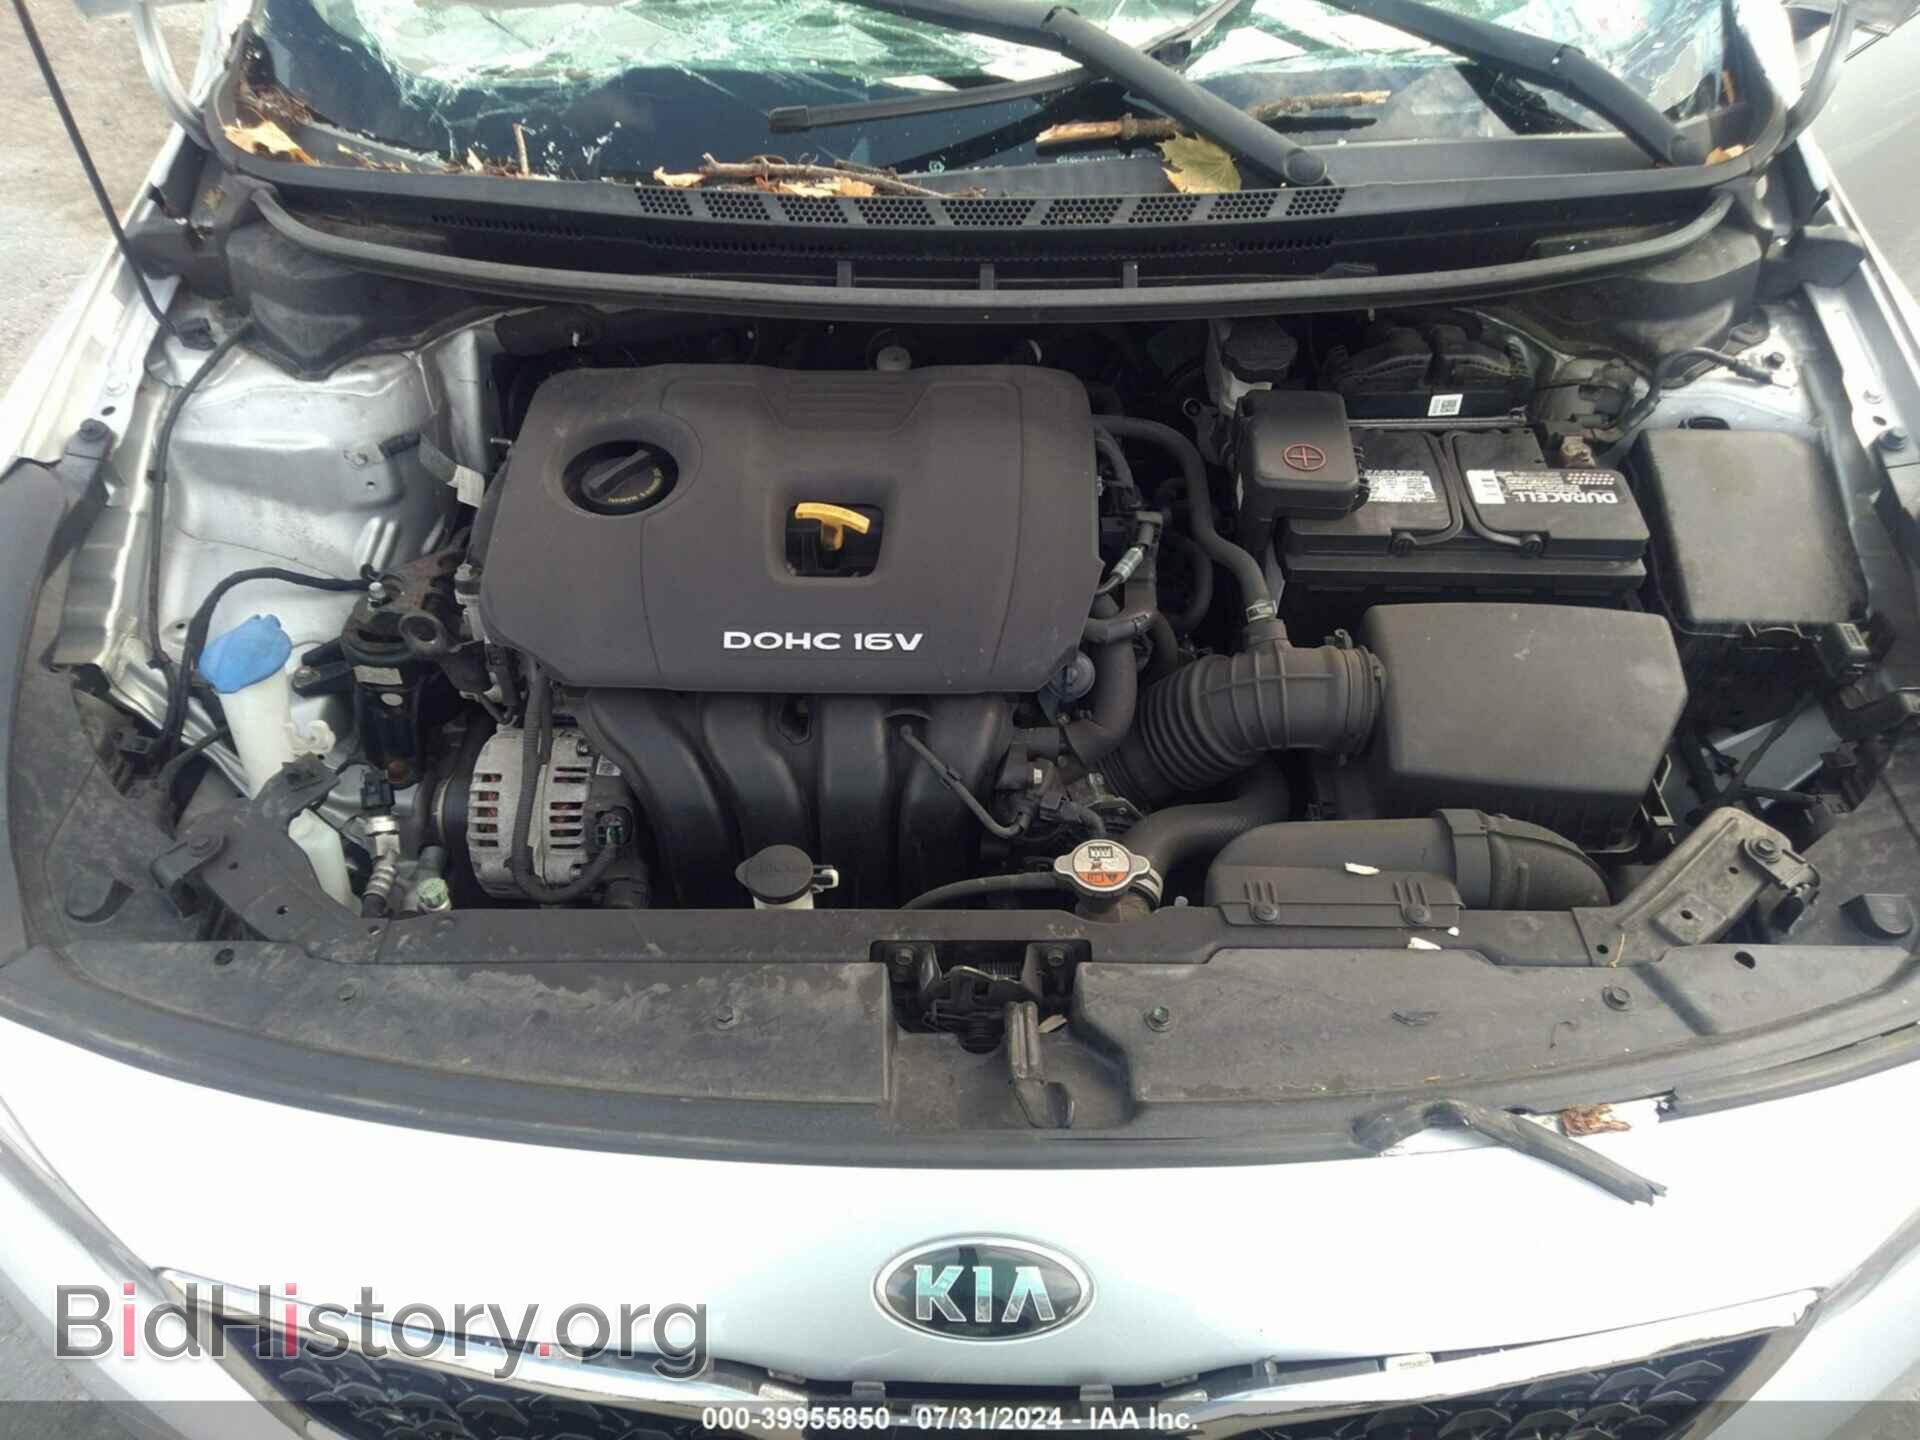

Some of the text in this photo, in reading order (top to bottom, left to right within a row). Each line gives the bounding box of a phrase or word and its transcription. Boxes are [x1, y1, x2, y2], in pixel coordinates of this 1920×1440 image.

[1511, 491, 1618, 503] DURACELL
[723, 631, 924, 651] DOHC 16V
[913, 1264, 1056, 1323] KIA
